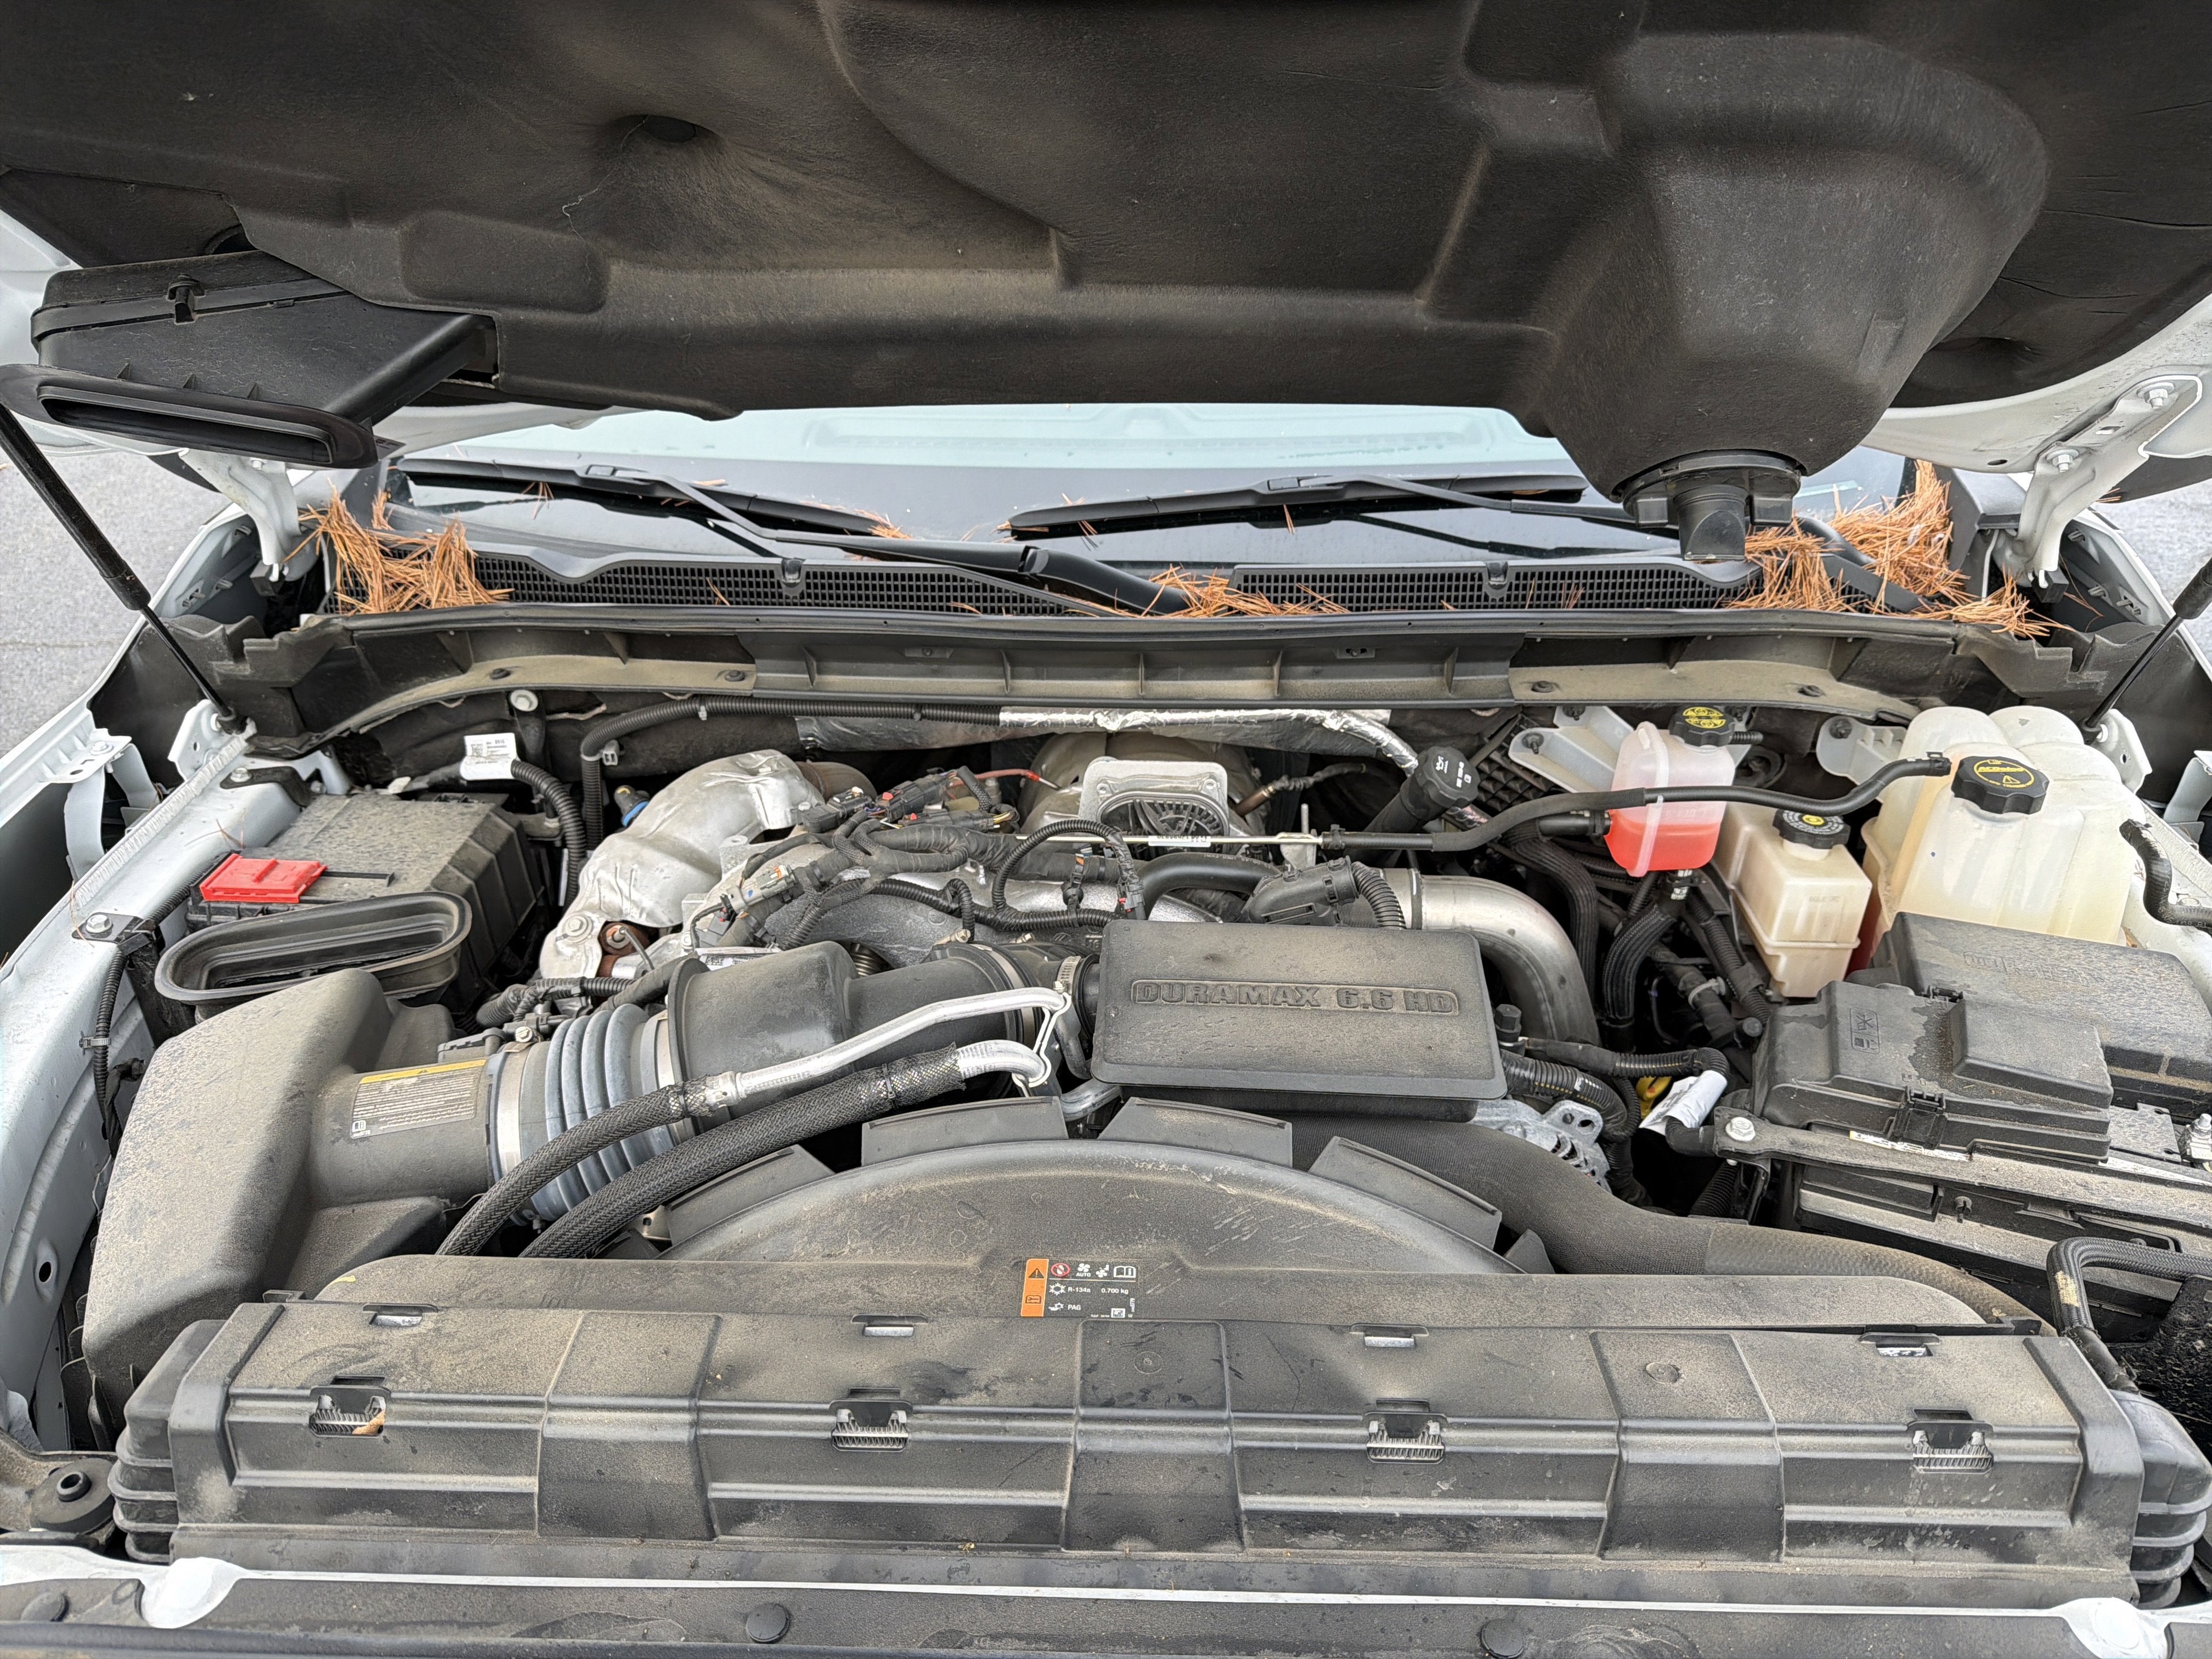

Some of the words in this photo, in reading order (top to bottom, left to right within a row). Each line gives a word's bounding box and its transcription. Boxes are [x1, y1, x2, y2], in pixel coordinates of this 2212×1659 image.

[1137, 983, 1321, 1008] DURAMAX
[1336, 988, 1394, 1011] 6.6
[1404, 991, 1457, 1013] HD
